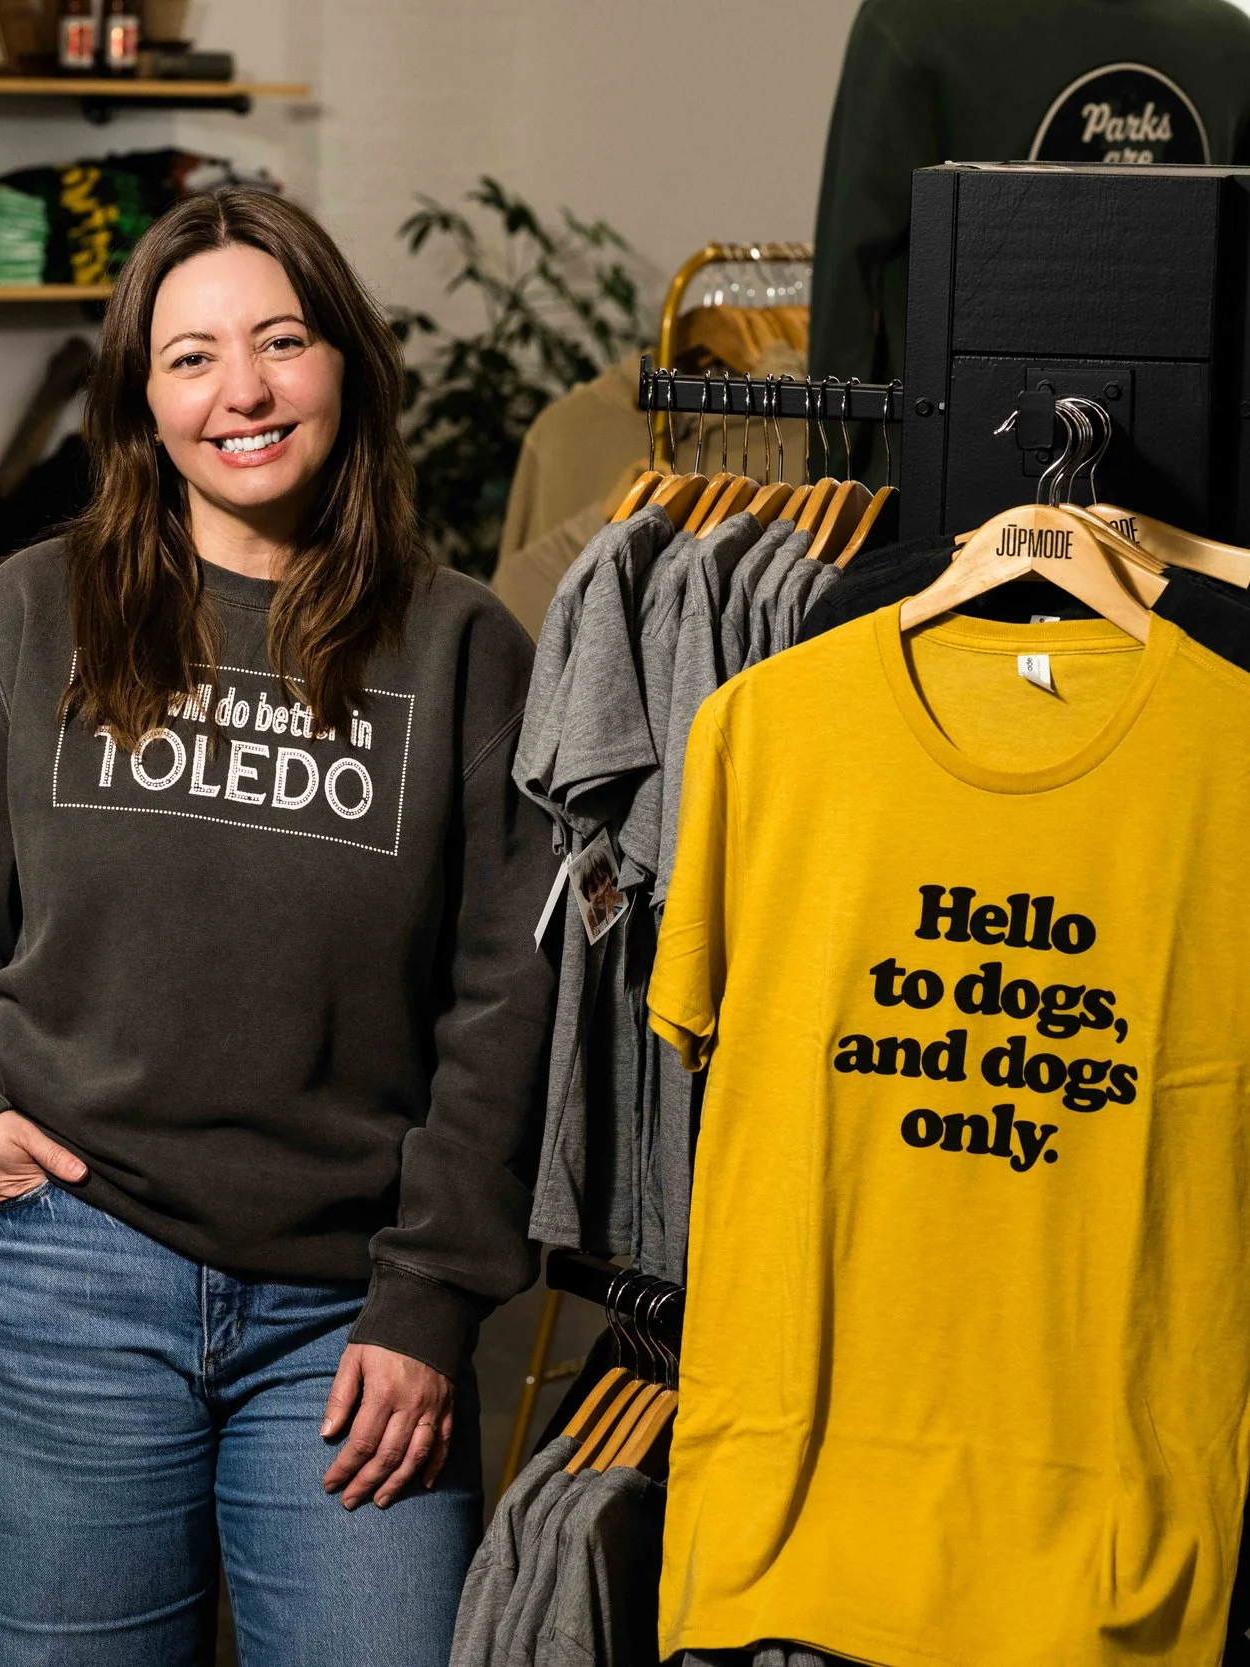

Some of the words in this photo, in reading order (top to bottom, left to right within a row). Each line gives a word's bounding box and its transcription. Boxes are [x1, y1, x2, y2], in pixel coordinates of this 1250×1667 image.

[1081, 101, 1173, 144] Parks
[215, 687, 250, 728] do
[350, 709, 372, 749] in
[95, 725, 373, 820] TOLEDO
[914, 884, 1097, 954] Hello
[869, 958, 944, 1009] to
[954, 961, 1128, 1043] dogs,
[833, 1029, 967, 1082] and
[981, 1035, 1138, 1113] dogs
[901, 1104, 1059, 1172] only.
